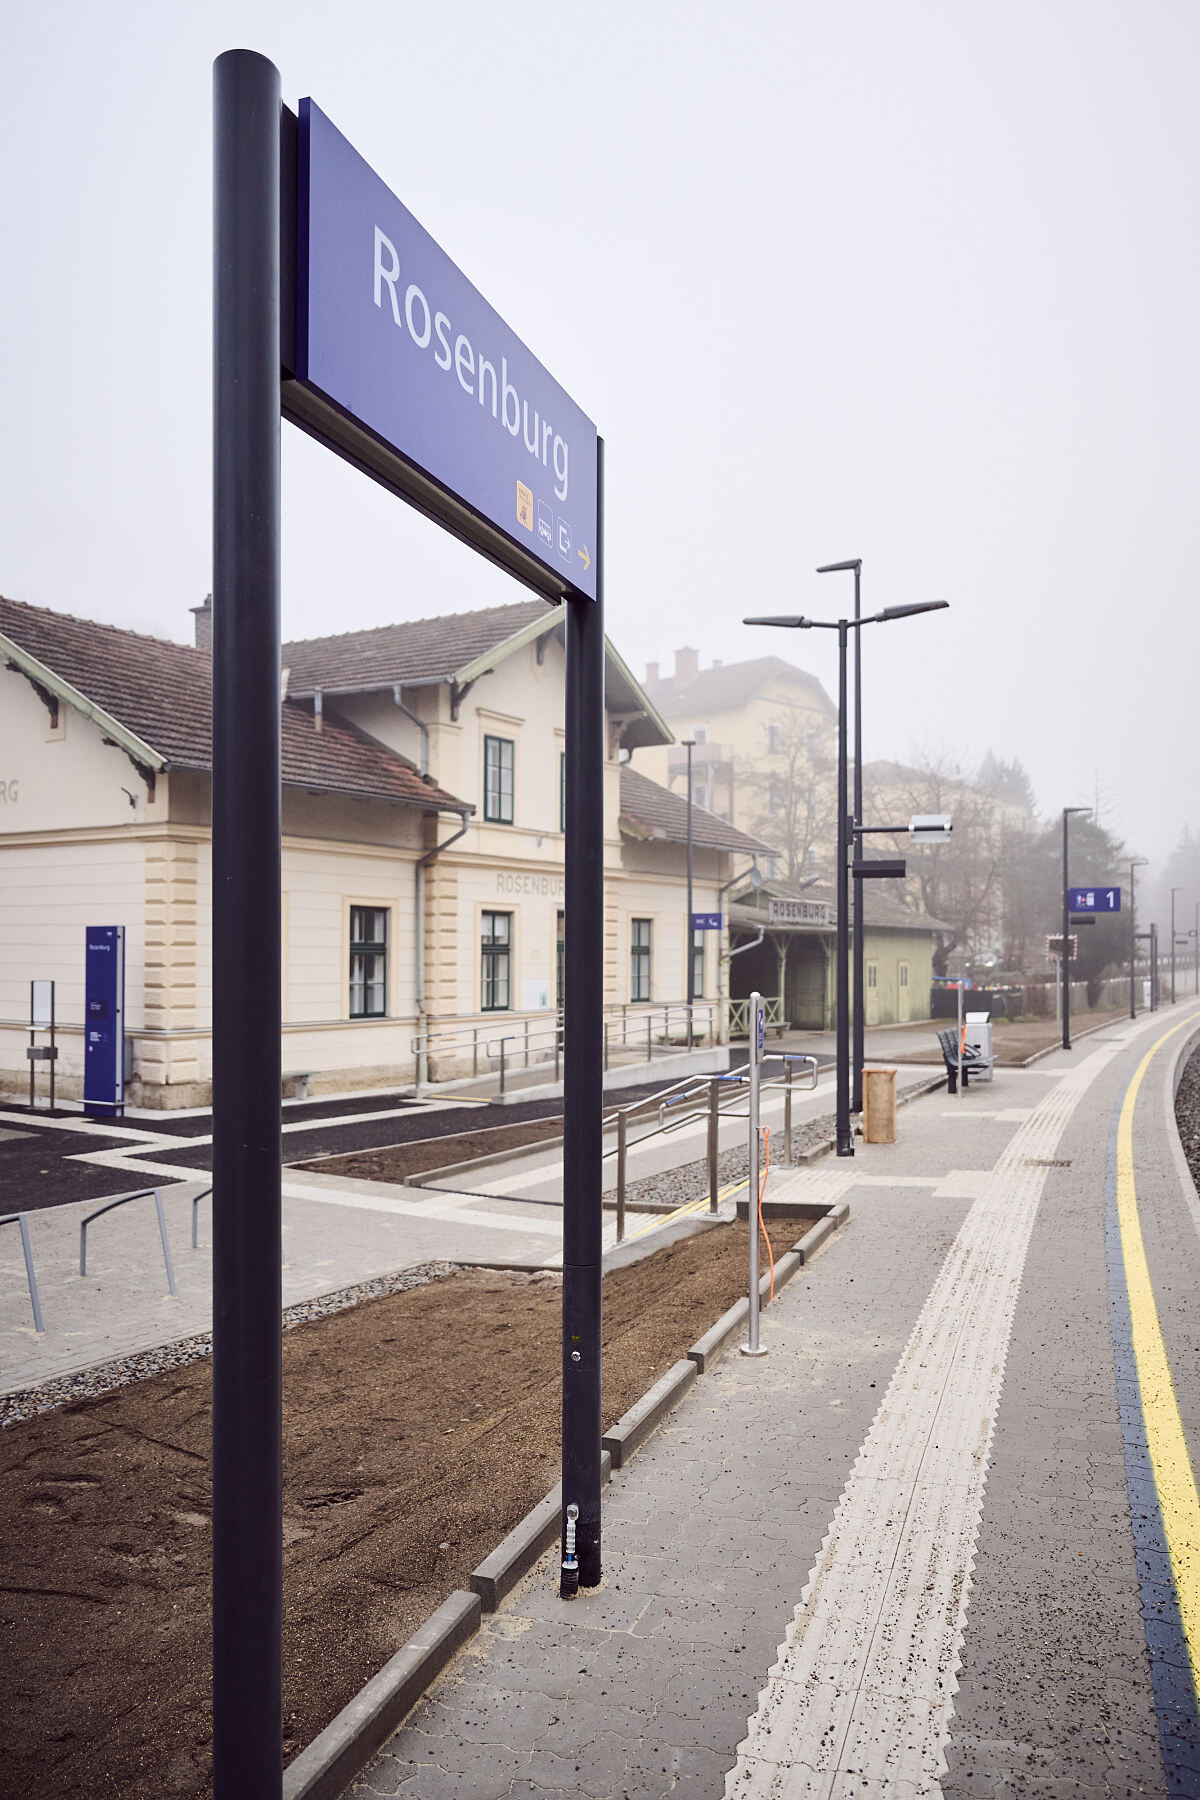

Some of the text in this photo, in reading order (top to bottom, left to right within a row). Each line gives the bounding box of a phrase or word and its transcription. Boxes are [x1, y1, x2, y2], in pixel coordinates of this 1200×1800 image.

[374, 224, 569, 501] Rosenburg
[0, 779, 19, 803] RG
[1105, 890, 1114, 908] 1
[773, 902, 827, 919] ROSENBURG
